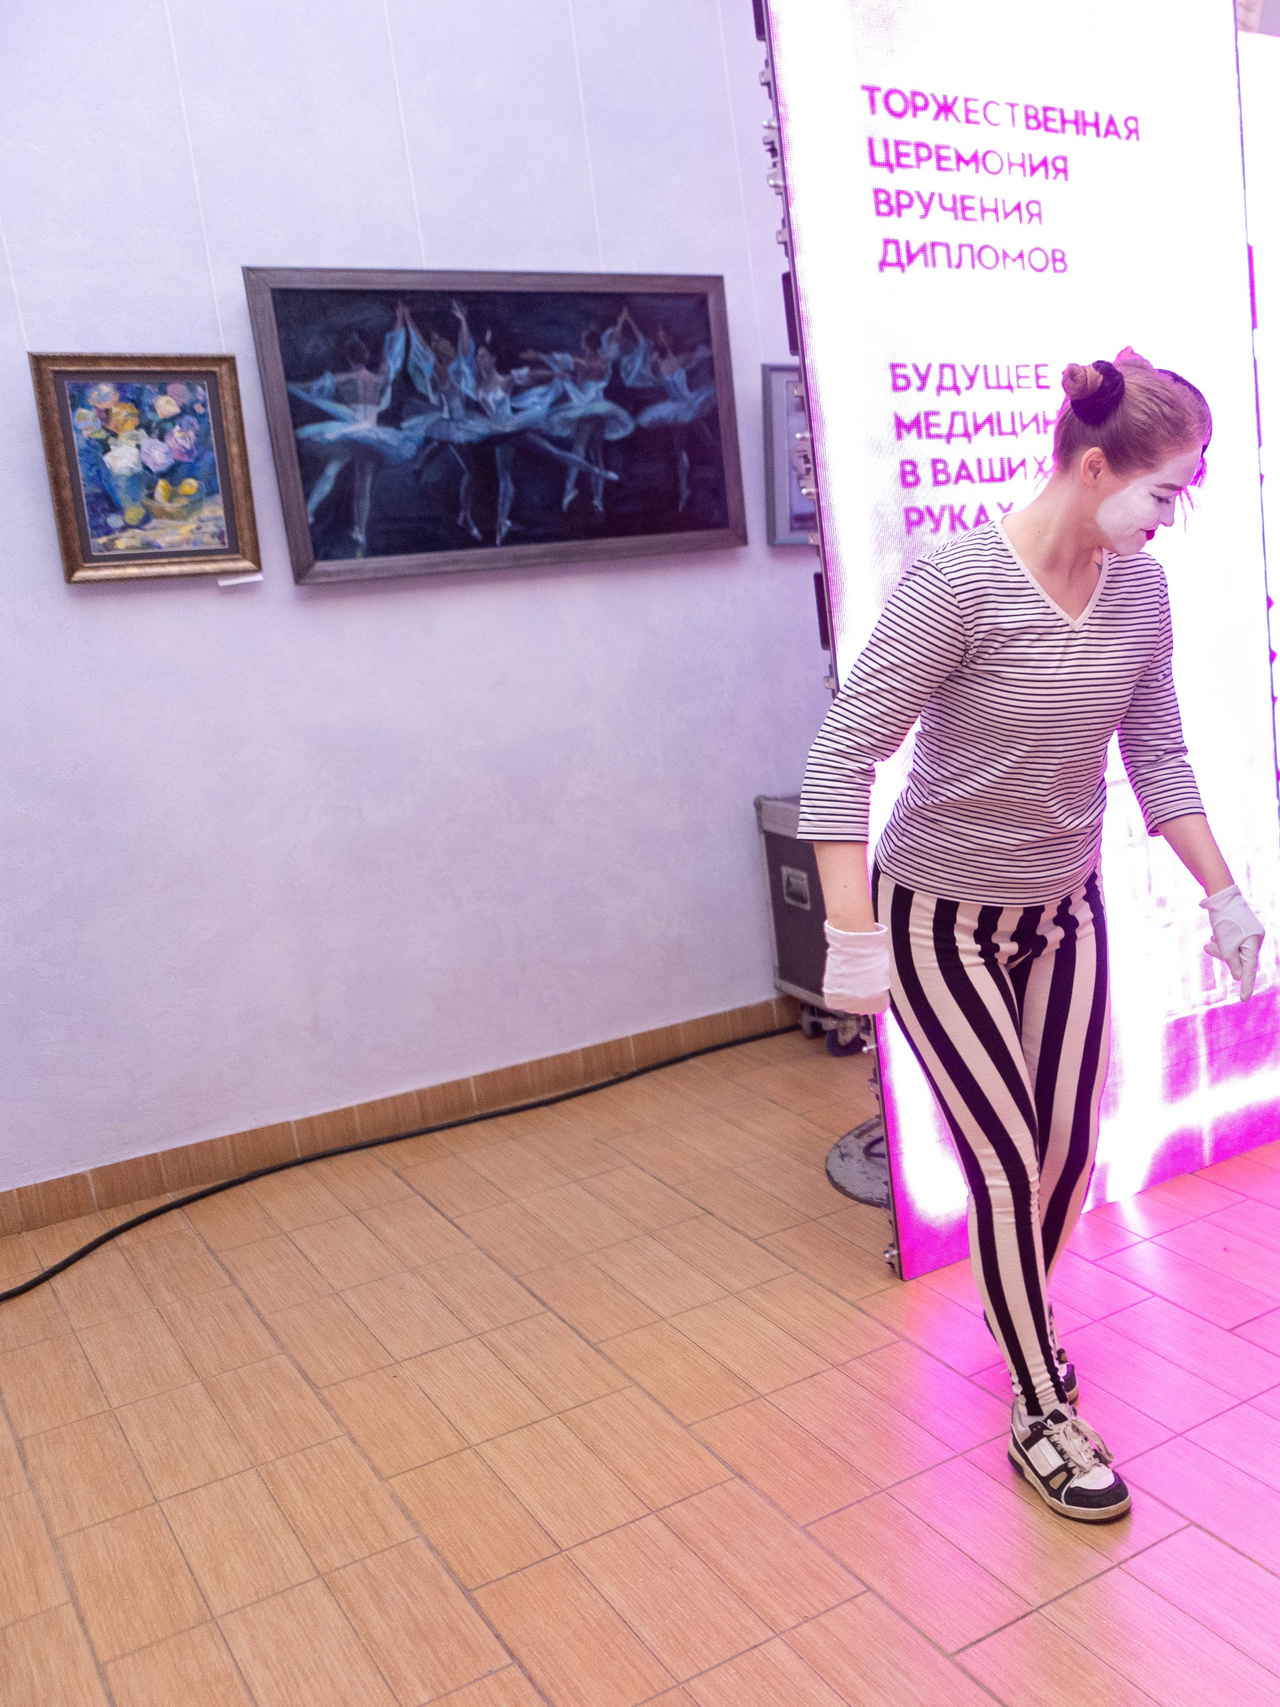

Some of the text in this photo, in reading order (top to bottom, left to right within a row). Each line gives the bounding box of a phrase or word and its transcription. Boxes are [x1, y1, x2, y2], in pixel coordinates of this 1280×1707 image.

[861, 83, 1140, 141] ТОРЖЕСТВЕННАЯ
[867, 136, 1069, 181] ЦЕРЕМОНИЯ
[873, 187, 1042, 225] ВРУЧЕНИЯ
[878, 237, 1068, 273] ДИПЛОМОВ
[889, 362, 1050, 397] БУДУЩЕЕ
[894, 409, 1060, 445] МЕДИЦИН
[900, 456, 1047, 489] В ВАШИХ
